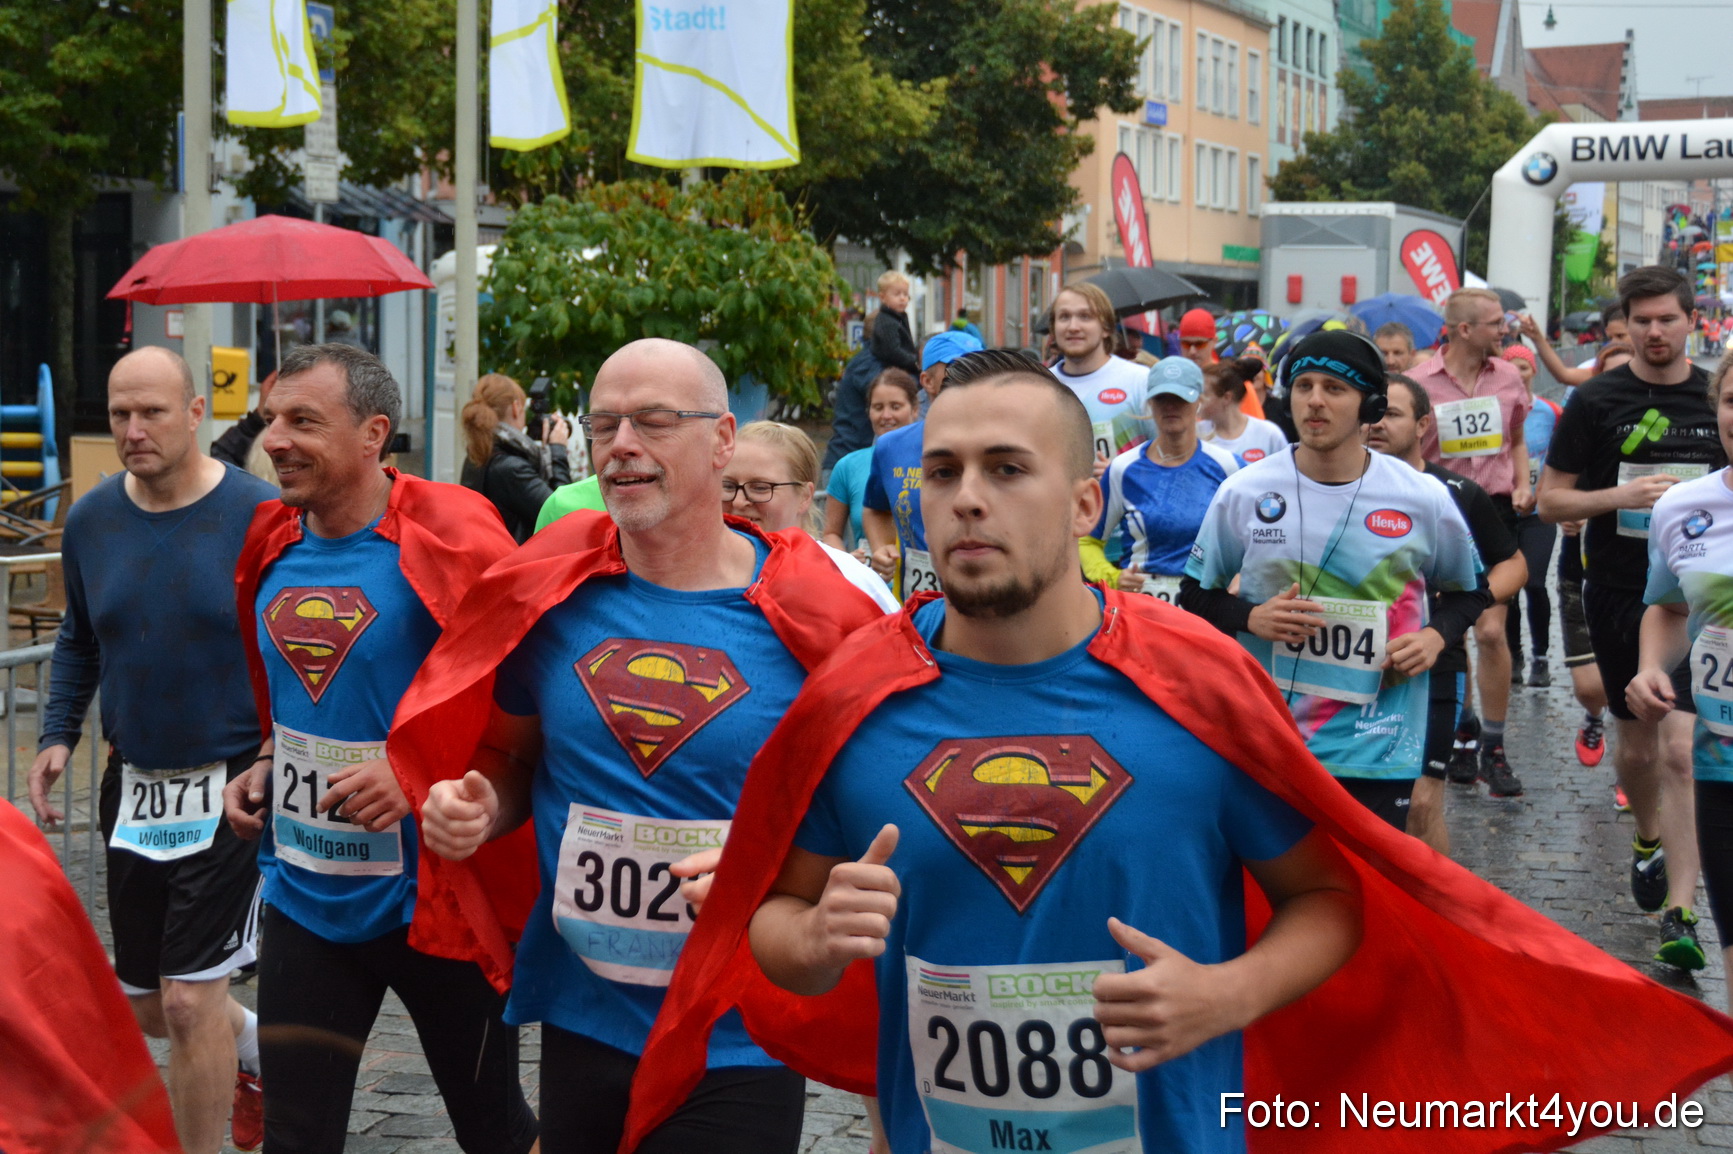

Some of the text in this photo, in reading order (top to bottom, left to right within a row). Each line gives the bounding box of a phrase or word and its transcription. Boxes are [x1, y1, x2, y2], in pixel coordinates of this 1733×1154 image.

[649, 4, 725, 31] Stadt!
[1571, 134, 1669, 161] BMW
[1452, 412, 1492, 436] 132
[1460, 439, 1488, 450] Martin
[893, 467, 904, 478] 10.
[1253, 528, 1286, 538] PARTL
[1371, 514, 1408, 532] Hervis
[1322, 601, 1377, 618] BOCK
[315, 742, 380, 763] BOCK
[131, 775, 210, 821] 2071
[138, 829, 201, 848] Wolfgang
[293, 825, 370, 861] Wolfgang
[577, 825, 624, 843] NeuerMarkt
[634, 823, 723, 847] BOCK
[574, 851, 704, 922] 302
[587, 931, 683, 959] FRANK
[917, 984, 976, 1002] NeuerMarkt
[987, 970, 1100, 999] BOCK
[991, 1000, 1024, 1009] inspired
[1027, 1000, 1037, 1008] by
[1040, 999, 1065, 1007] smart
[927, 1015, 1113, 1099] 2088
[923, 1080, 931, 1094] D
[989, 1119, 1052, 1151] Max
